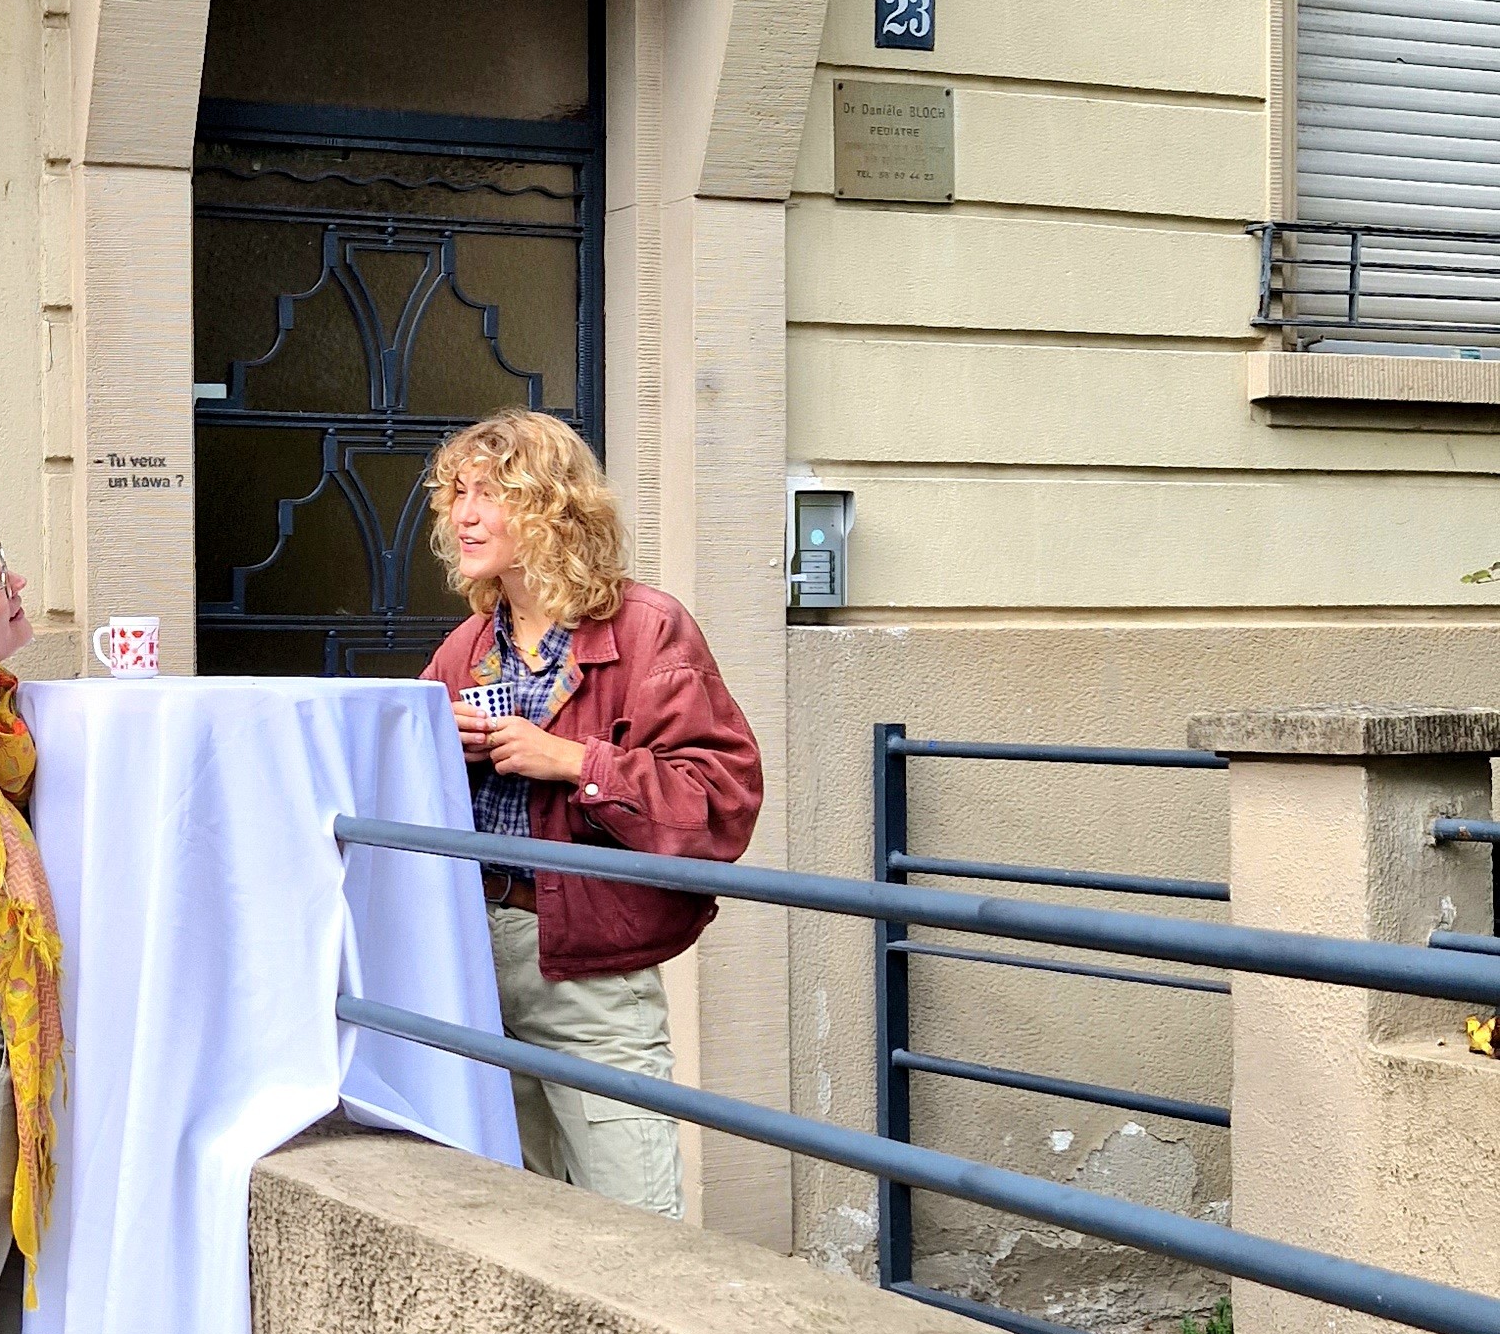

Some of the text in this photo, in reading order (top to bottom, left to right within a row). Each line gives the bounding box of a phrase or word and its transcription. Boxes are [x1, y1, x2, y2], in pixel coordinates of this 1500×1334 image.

[843, 102, 856, 114] Dr
[909, 105, 946, 119] BLOCH
[869, 126, 920, 138] PEDIATRE
[106, 453, 126, 468] Tu
[129, 456, 167, 468] veux
[108, 474, 184, 488] un kawa ?
